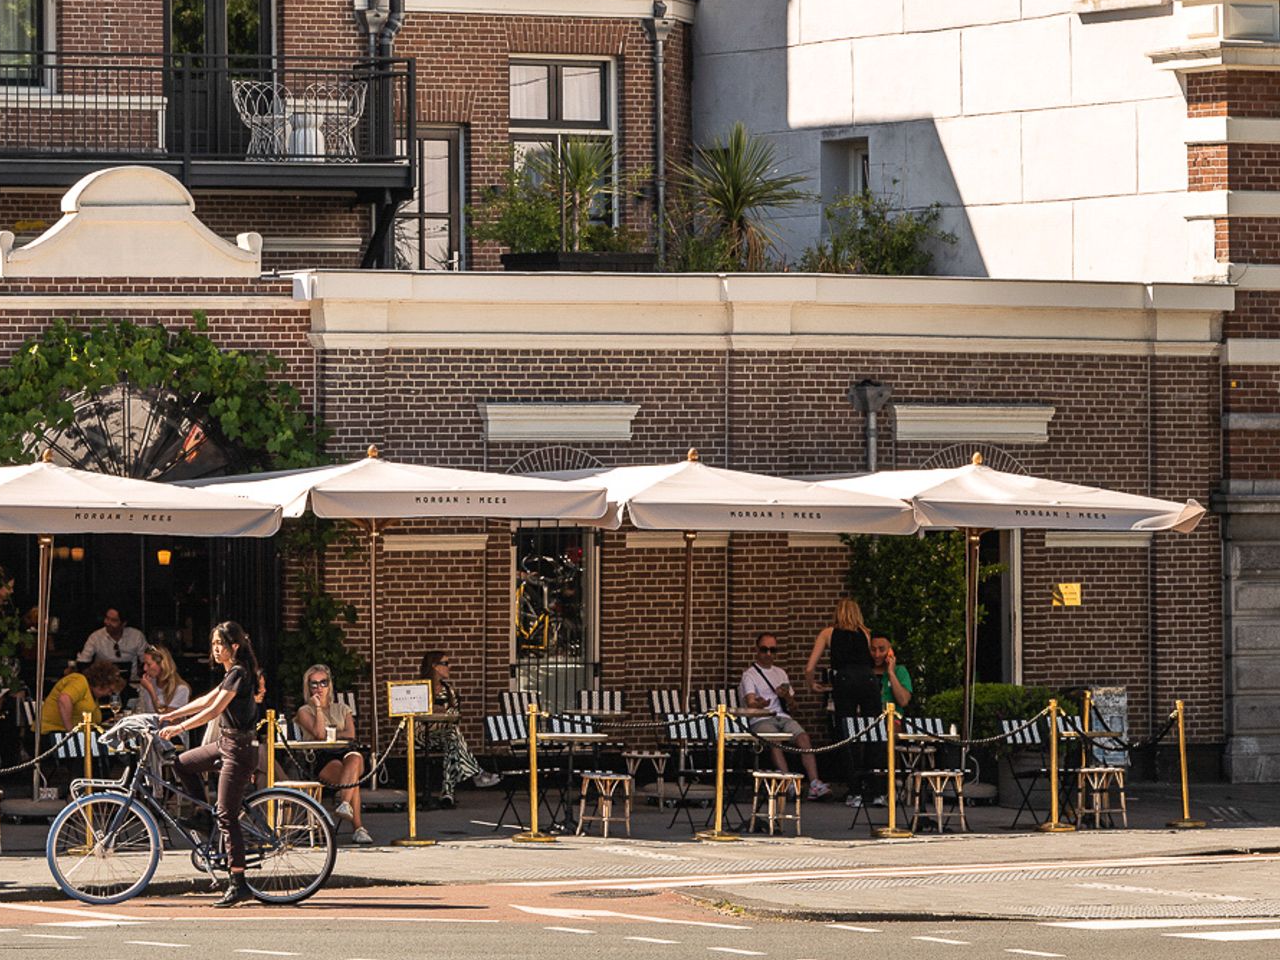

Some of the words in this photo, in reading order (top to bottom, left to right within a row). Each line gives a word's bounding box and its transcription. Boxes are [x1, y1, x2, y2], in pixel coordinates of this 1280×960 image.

[479, 496, 508, 504] MEES
[74, 512, 121, 520] MORGAN
[142, 514, 172, 522] MEES
[1015, 509, 1059, 517] MORGAN
[1078, 512, 1107, 520] MEES
